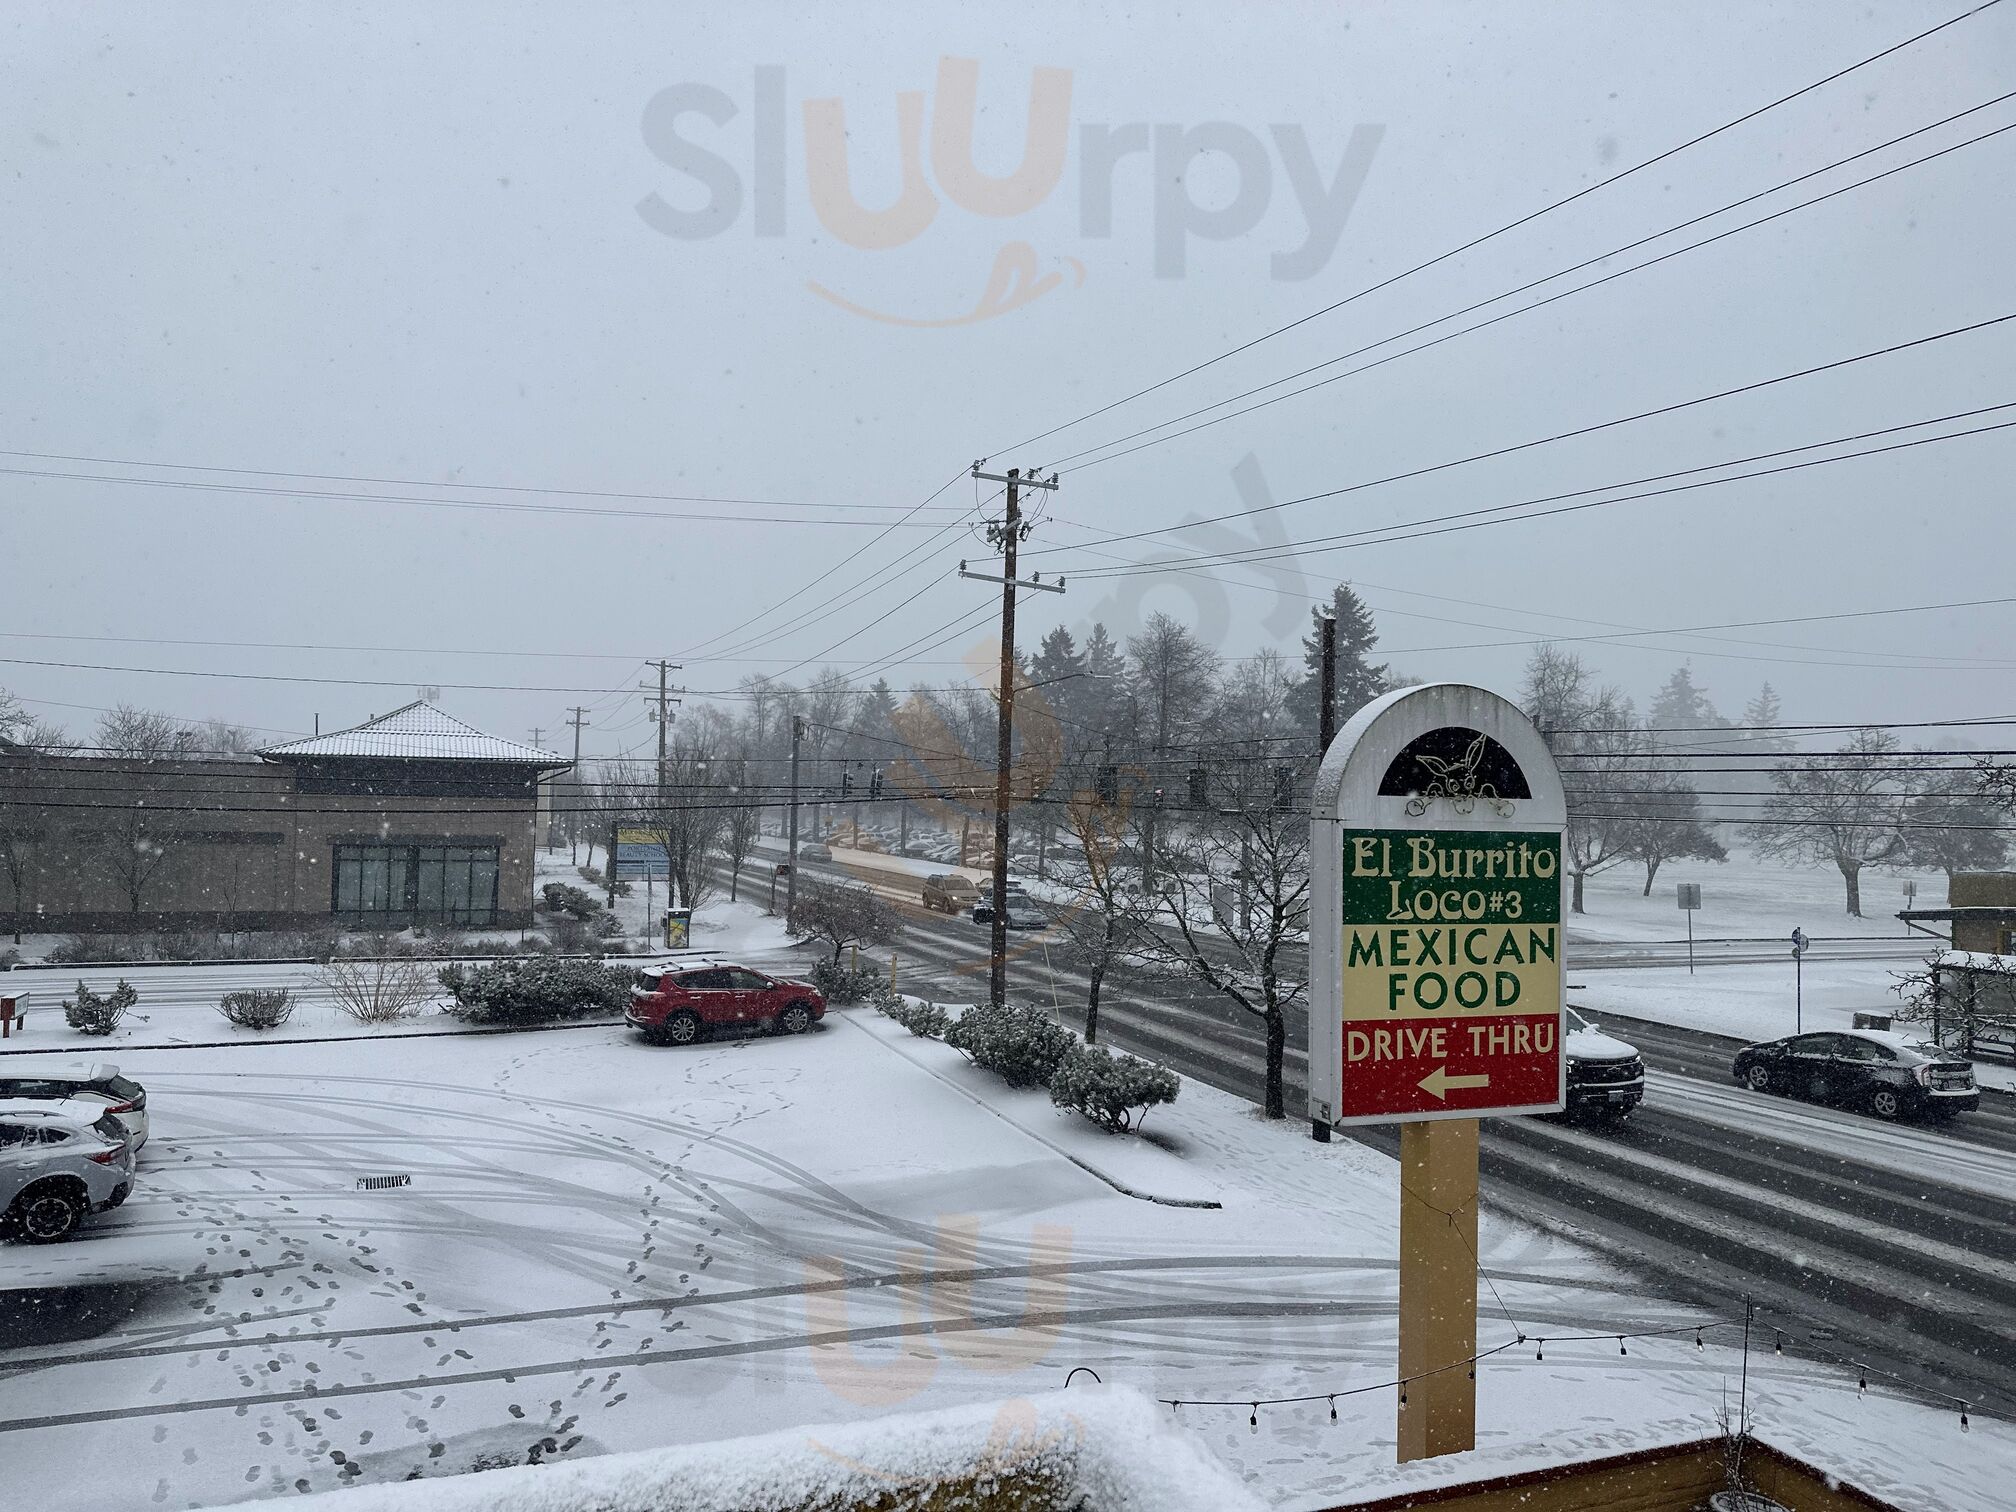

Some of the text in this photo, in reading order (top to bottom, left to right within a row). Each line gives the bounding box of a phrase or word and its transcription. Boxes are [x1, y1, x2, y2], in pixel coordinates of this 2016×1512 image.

[1351, 837, 1556, 878] El Burrito
[1348, 928, 1555, 967] MEXICAN
[1389, 971, 1521, 1010] FOOD
[1347, 1023, 1554, 1062] DRIVE THRU
